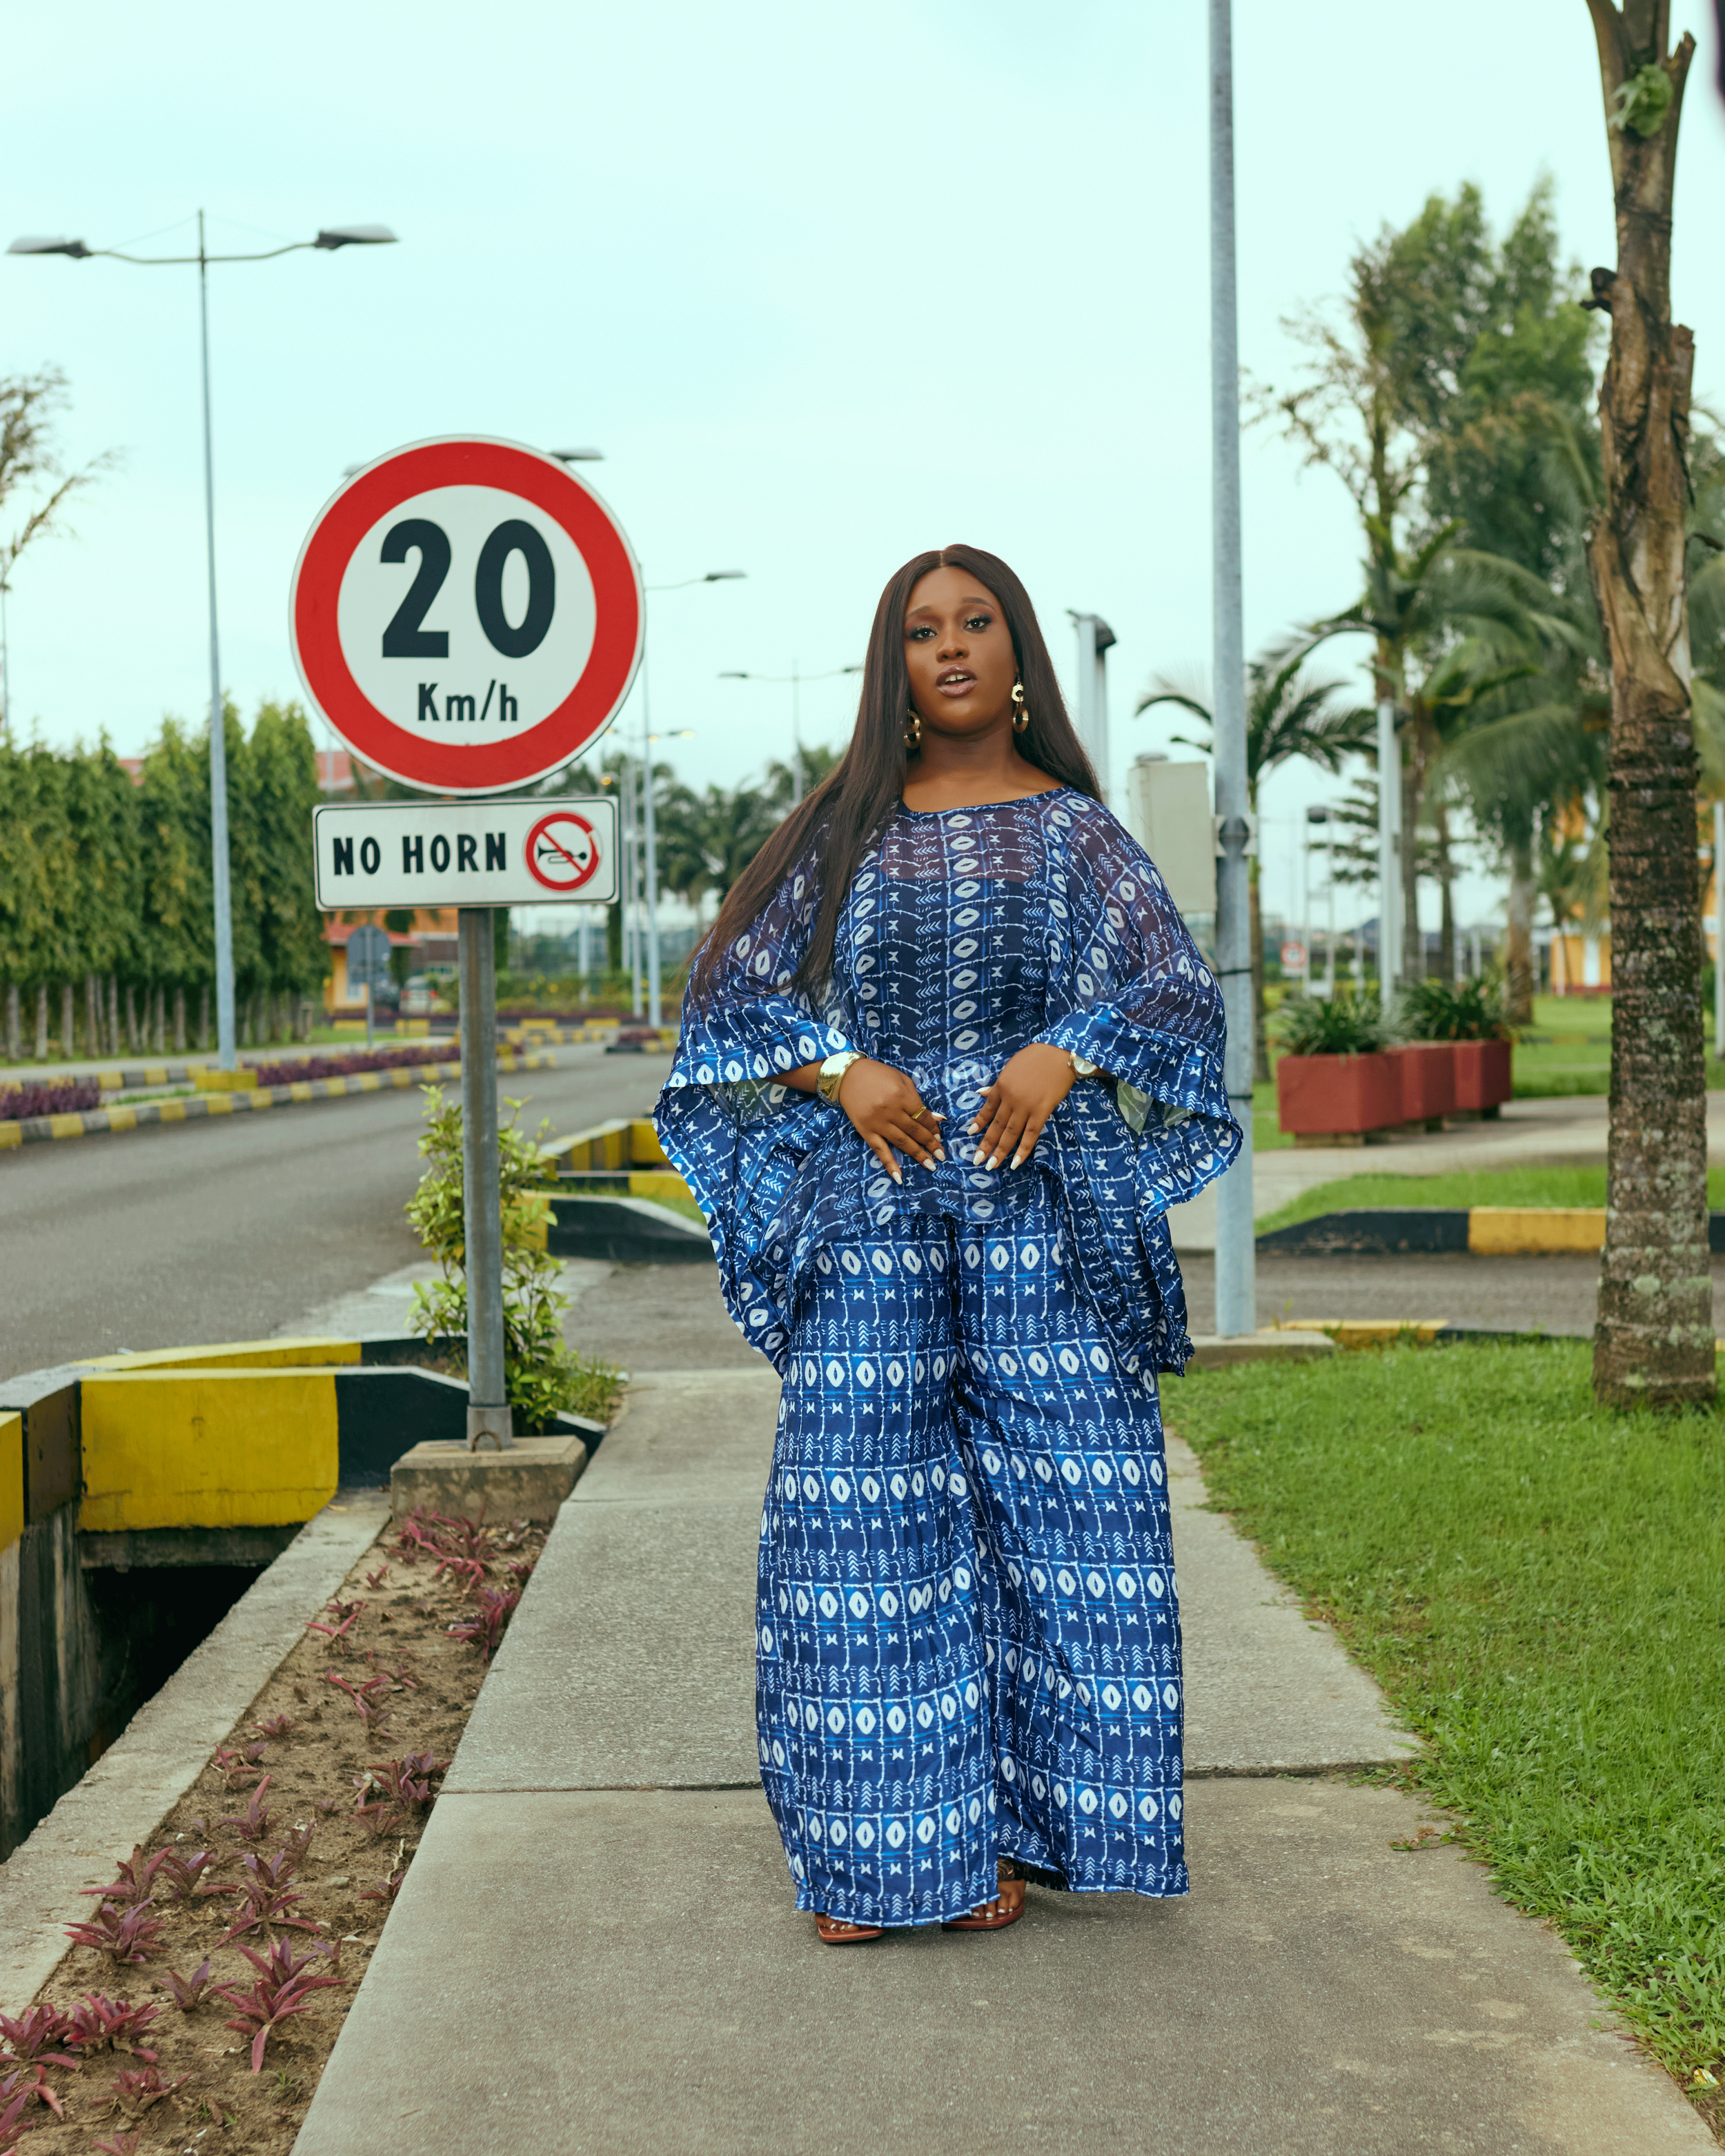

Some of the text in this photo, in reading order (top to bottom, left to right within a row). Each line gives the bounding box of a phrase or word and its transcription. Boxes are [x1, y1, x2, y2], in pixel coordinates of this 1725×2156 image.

[380, 518, 555, 658] 20
[417, 679, 518, 722] Km/h
[333, 832, 506, 876] NO HORN
